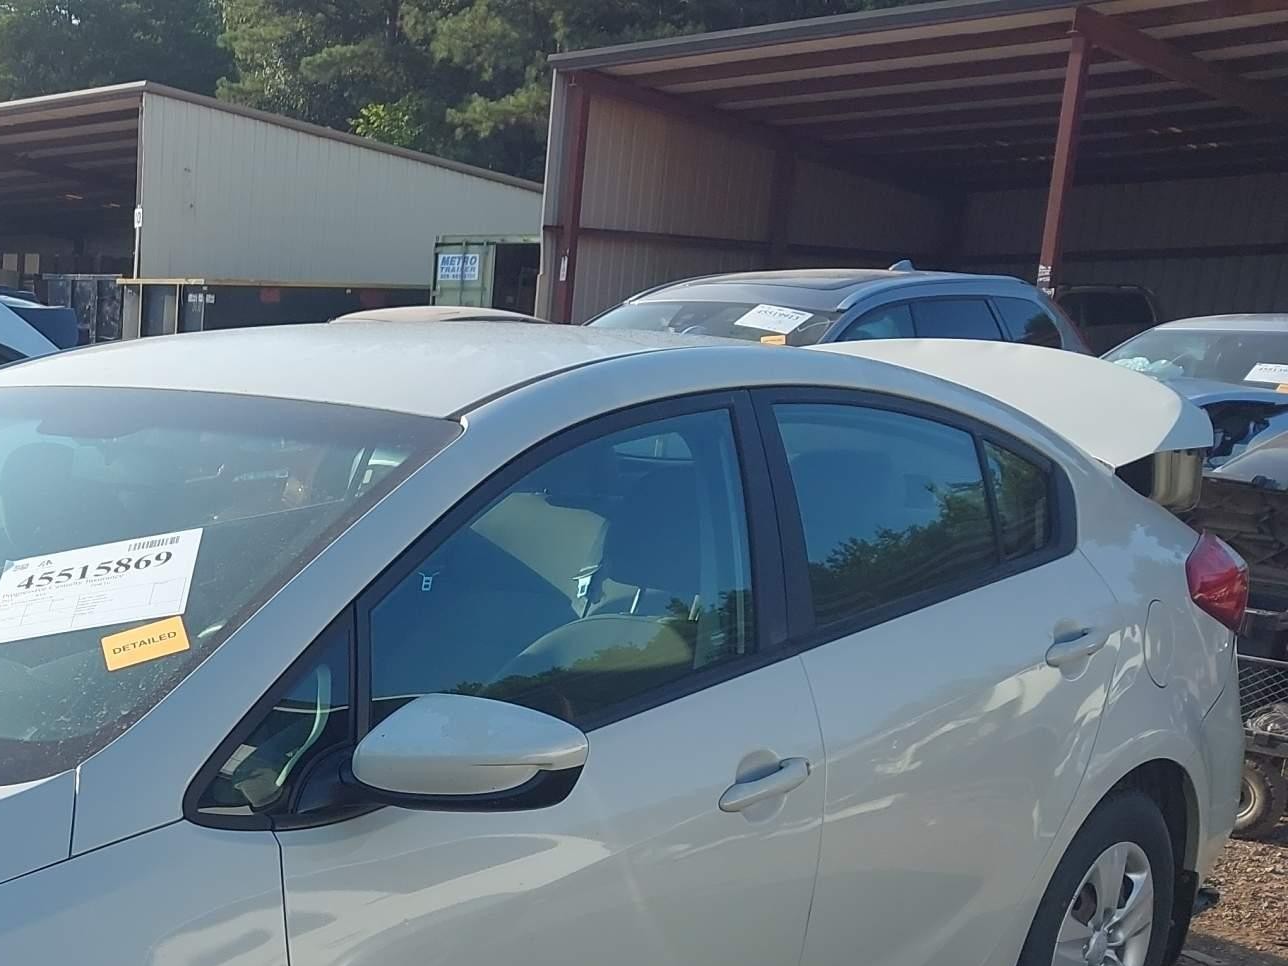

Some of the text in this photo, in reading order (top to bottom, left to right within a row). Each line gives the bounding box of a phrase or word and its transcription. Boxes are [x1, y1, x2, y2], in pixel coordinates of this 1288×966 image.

[441, 255, 477, 266] METRO
[17, 551, 172, 589] 45515869
[112, 631, 177, 655] DETAILED
